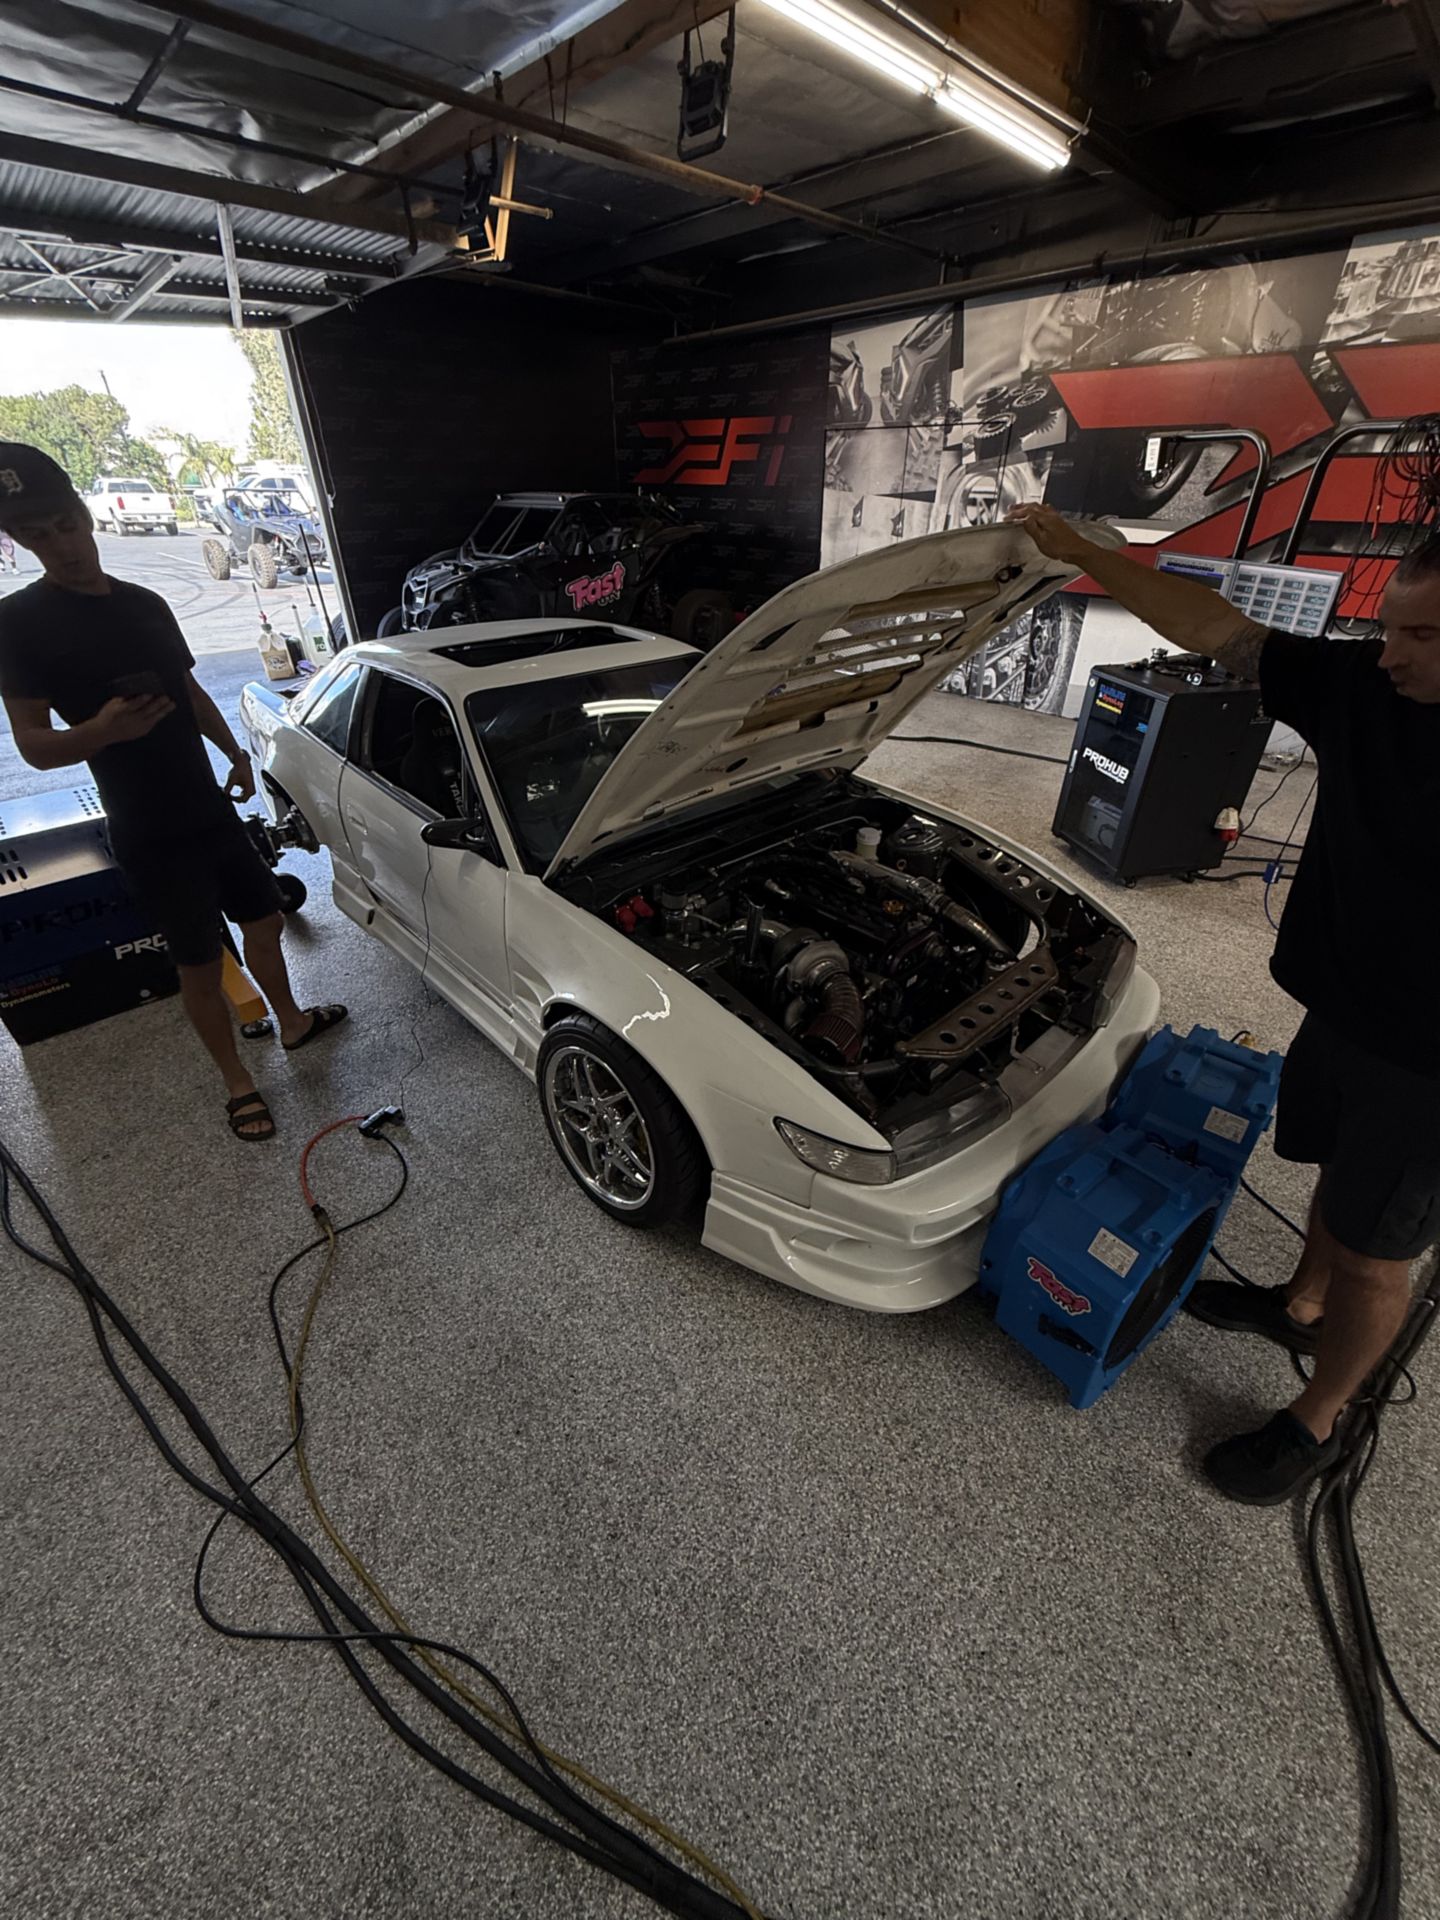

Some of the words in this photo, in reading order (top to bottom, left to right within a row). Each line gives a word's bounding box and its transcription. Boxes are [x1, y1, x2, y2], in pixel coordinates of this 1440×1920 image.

[565, 561, 626, 611] Fast
[1083, 747, 1129, 780] PROHUB
[114, 933, 168, 960] PRO
